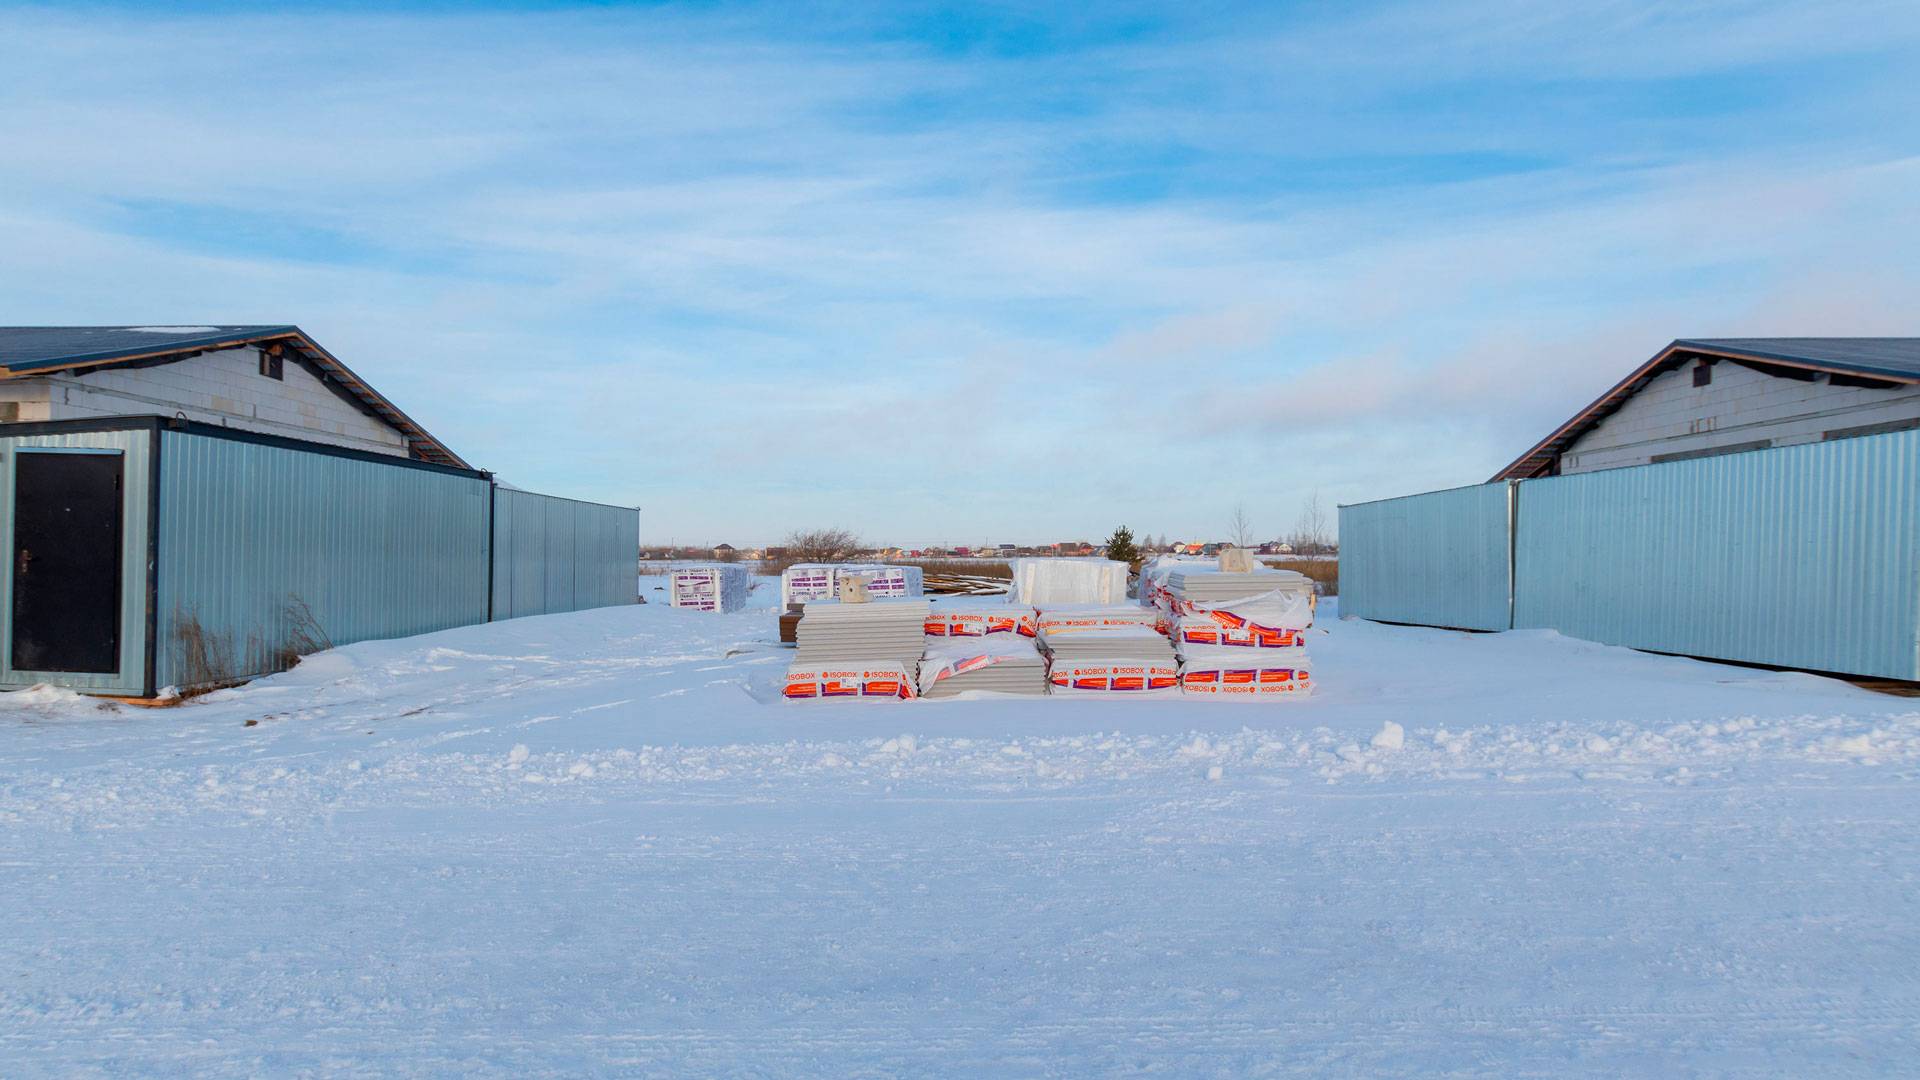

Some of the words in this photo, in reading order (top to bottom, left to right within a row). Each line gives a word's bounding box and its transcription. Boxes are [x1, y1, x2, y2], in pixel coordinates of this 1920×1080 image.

[1081, 666, 1107, 675] ISOBOX
[788, 672, 815, 681] ISOBOX
[1184, 685, 1209, 693] ISOBOX
[1261, 685, 1286, 693] ISOBOX
